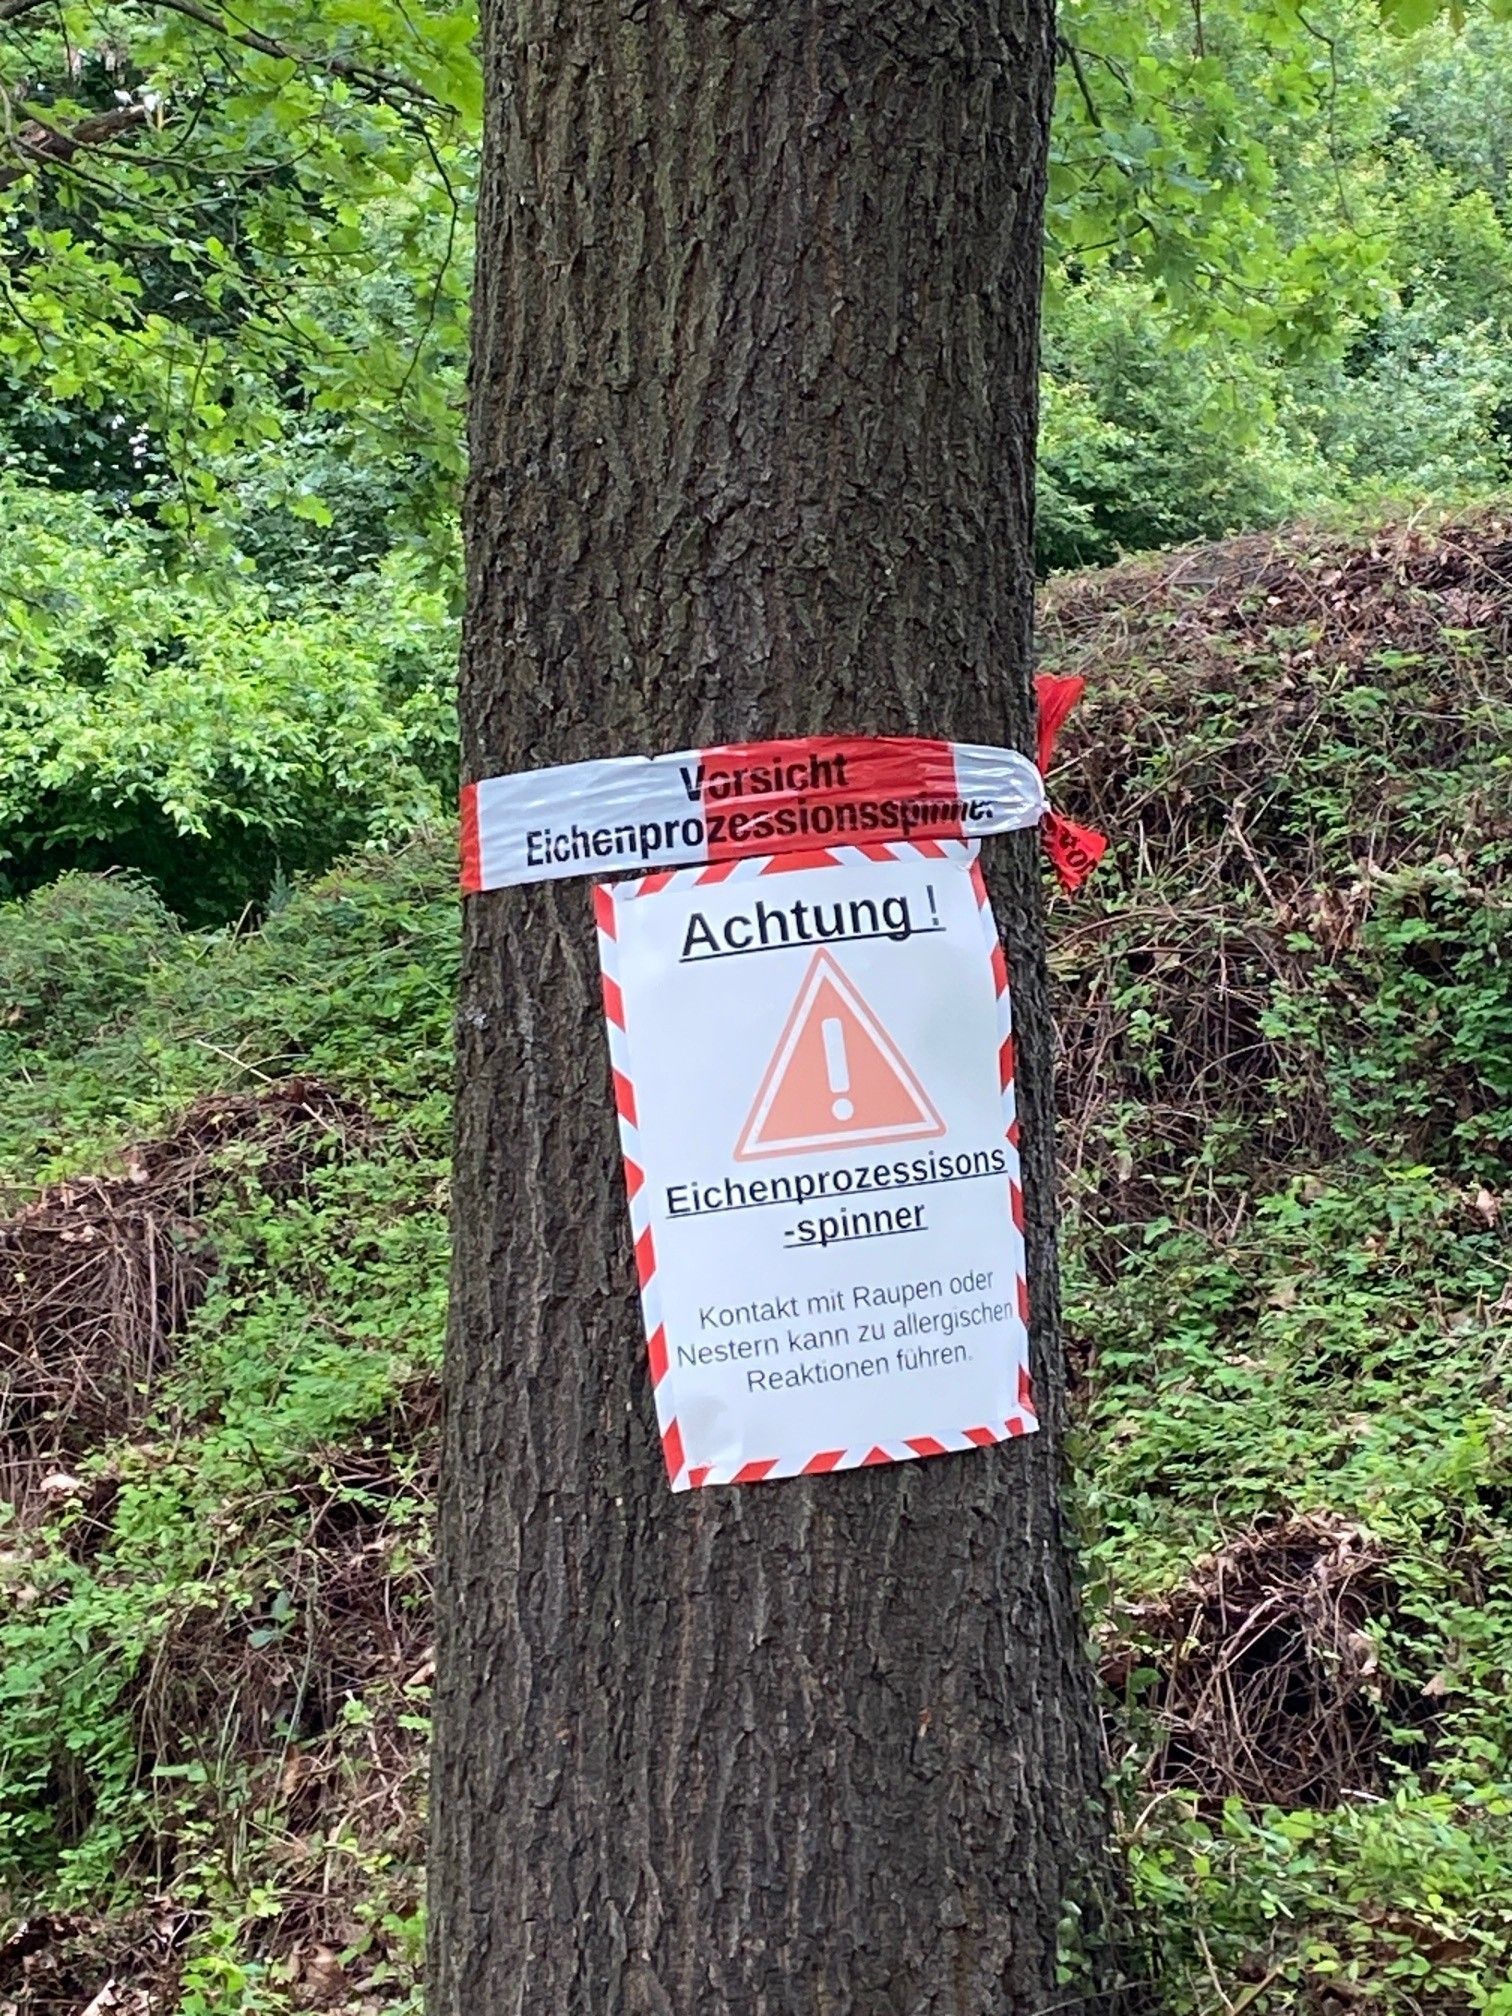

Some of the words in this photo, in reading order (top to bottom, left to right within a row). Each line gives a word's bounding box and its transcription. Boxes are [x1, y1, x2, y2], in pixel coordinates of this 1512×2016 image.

[679, 753, 849, 801] Vorsicht
[682, 895, 910, 956] Achtung
[925, 884, 940, 926] !
[666, 1147, 1006, 1215] Eichenprozessisons
[784, 1202, 925, 1247] -spinner
[699, 1296, 800, 1330] Kontakt
[807, 1288, 845, 1315] mit
[853, 1279, 943, 1309] Raupen
[949, 1269, 994, 1295] oder
[677, 1336, 780, 1368] Nestern
[787, 1326, 850, 1353] kann
[858, 1322, 886, 1343] zu
[893, 1301, 1014, 1336] allergischen
[746, 1355, 890, 1392] Reaktionen
[896, 1343, 974, 1372] führen.
